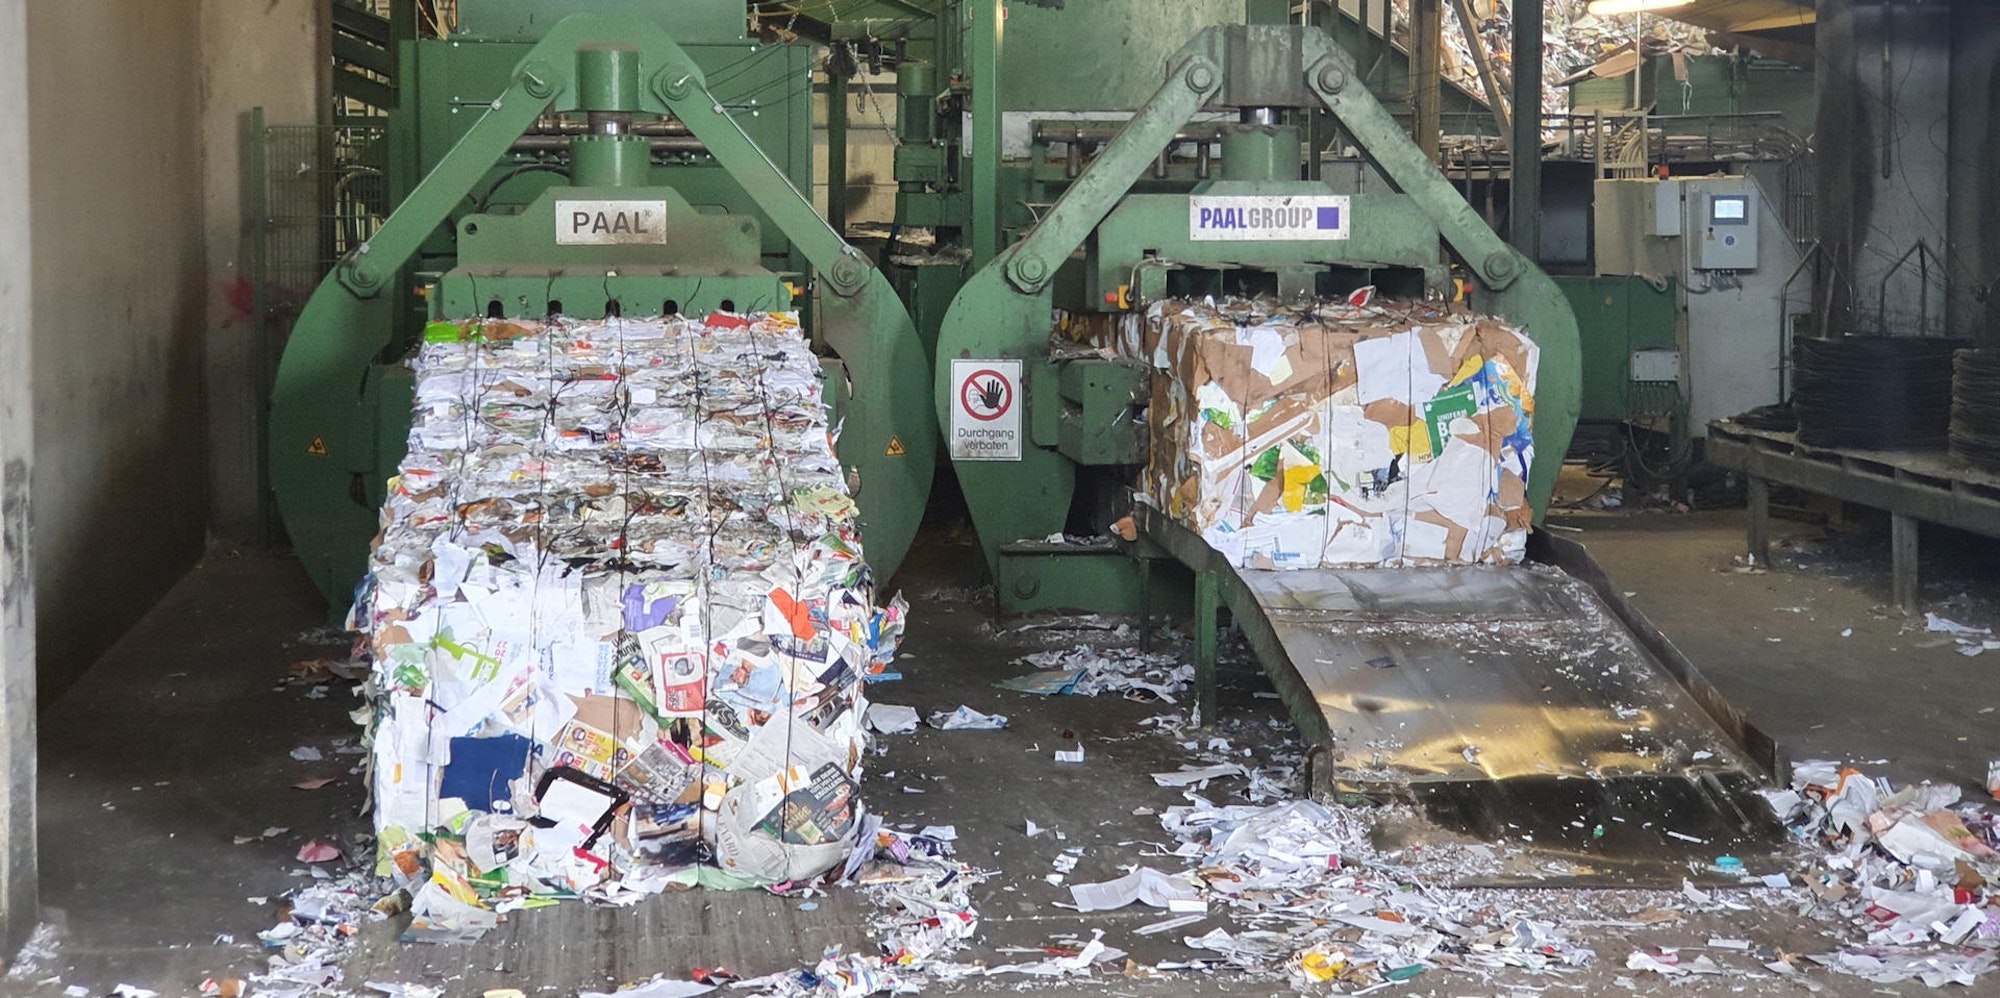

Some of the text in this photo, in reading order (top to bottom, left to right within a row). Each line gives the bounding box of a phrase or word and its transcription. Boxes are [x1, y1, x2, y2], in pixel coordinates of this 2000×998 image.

[1199, 207, 1313, 229] PAALGROUP
[958, 428, 1014, 439] Durchgang
[964, 440, 1008, 450] verboten
